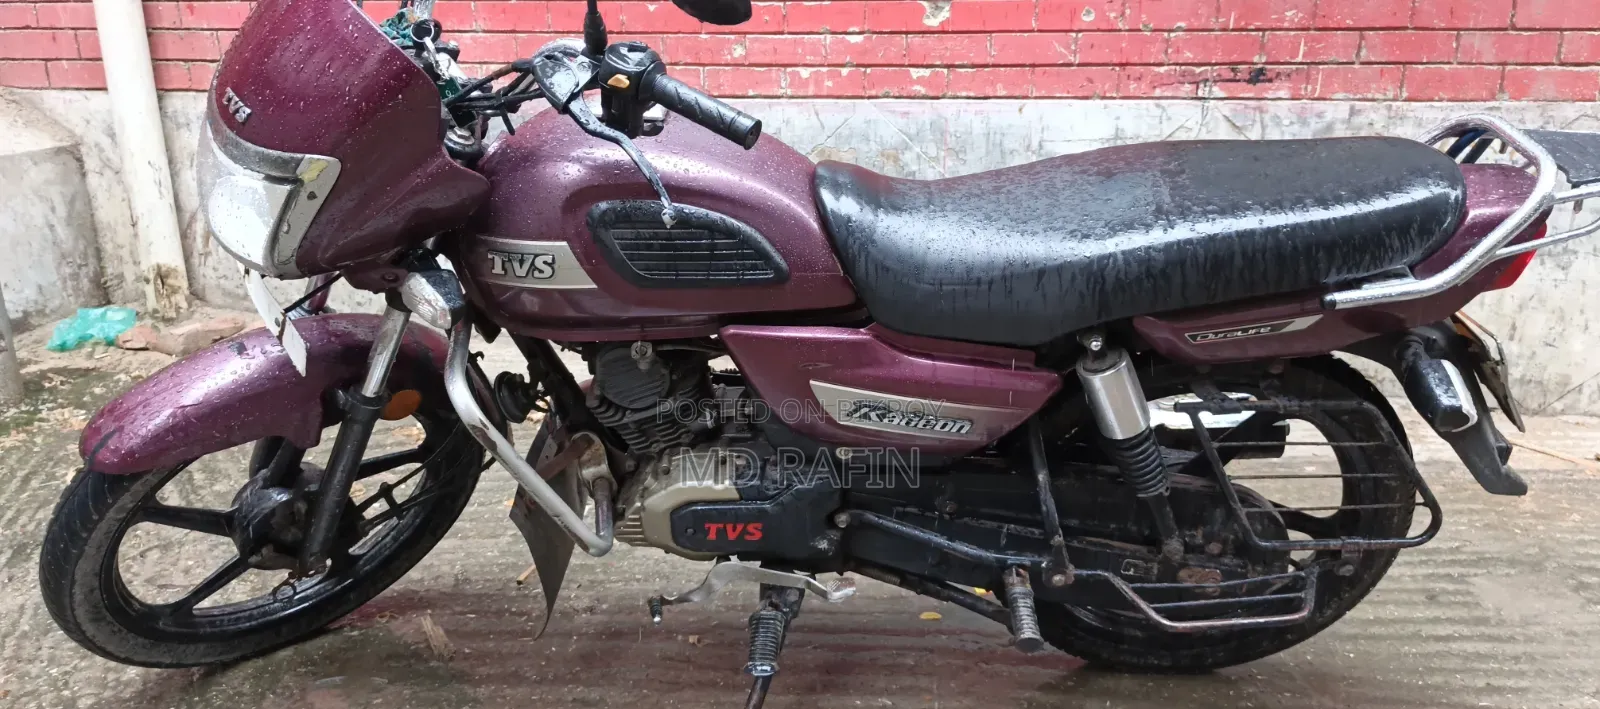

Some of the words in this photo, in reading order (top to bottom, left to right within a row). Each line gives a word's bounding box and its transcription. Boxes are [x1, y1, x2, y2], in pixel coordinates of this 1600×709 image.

[221, 86, 252, 123] TVS
[487, 250, 555, 279] TVS
[704, 523, 763, 541] TVS
